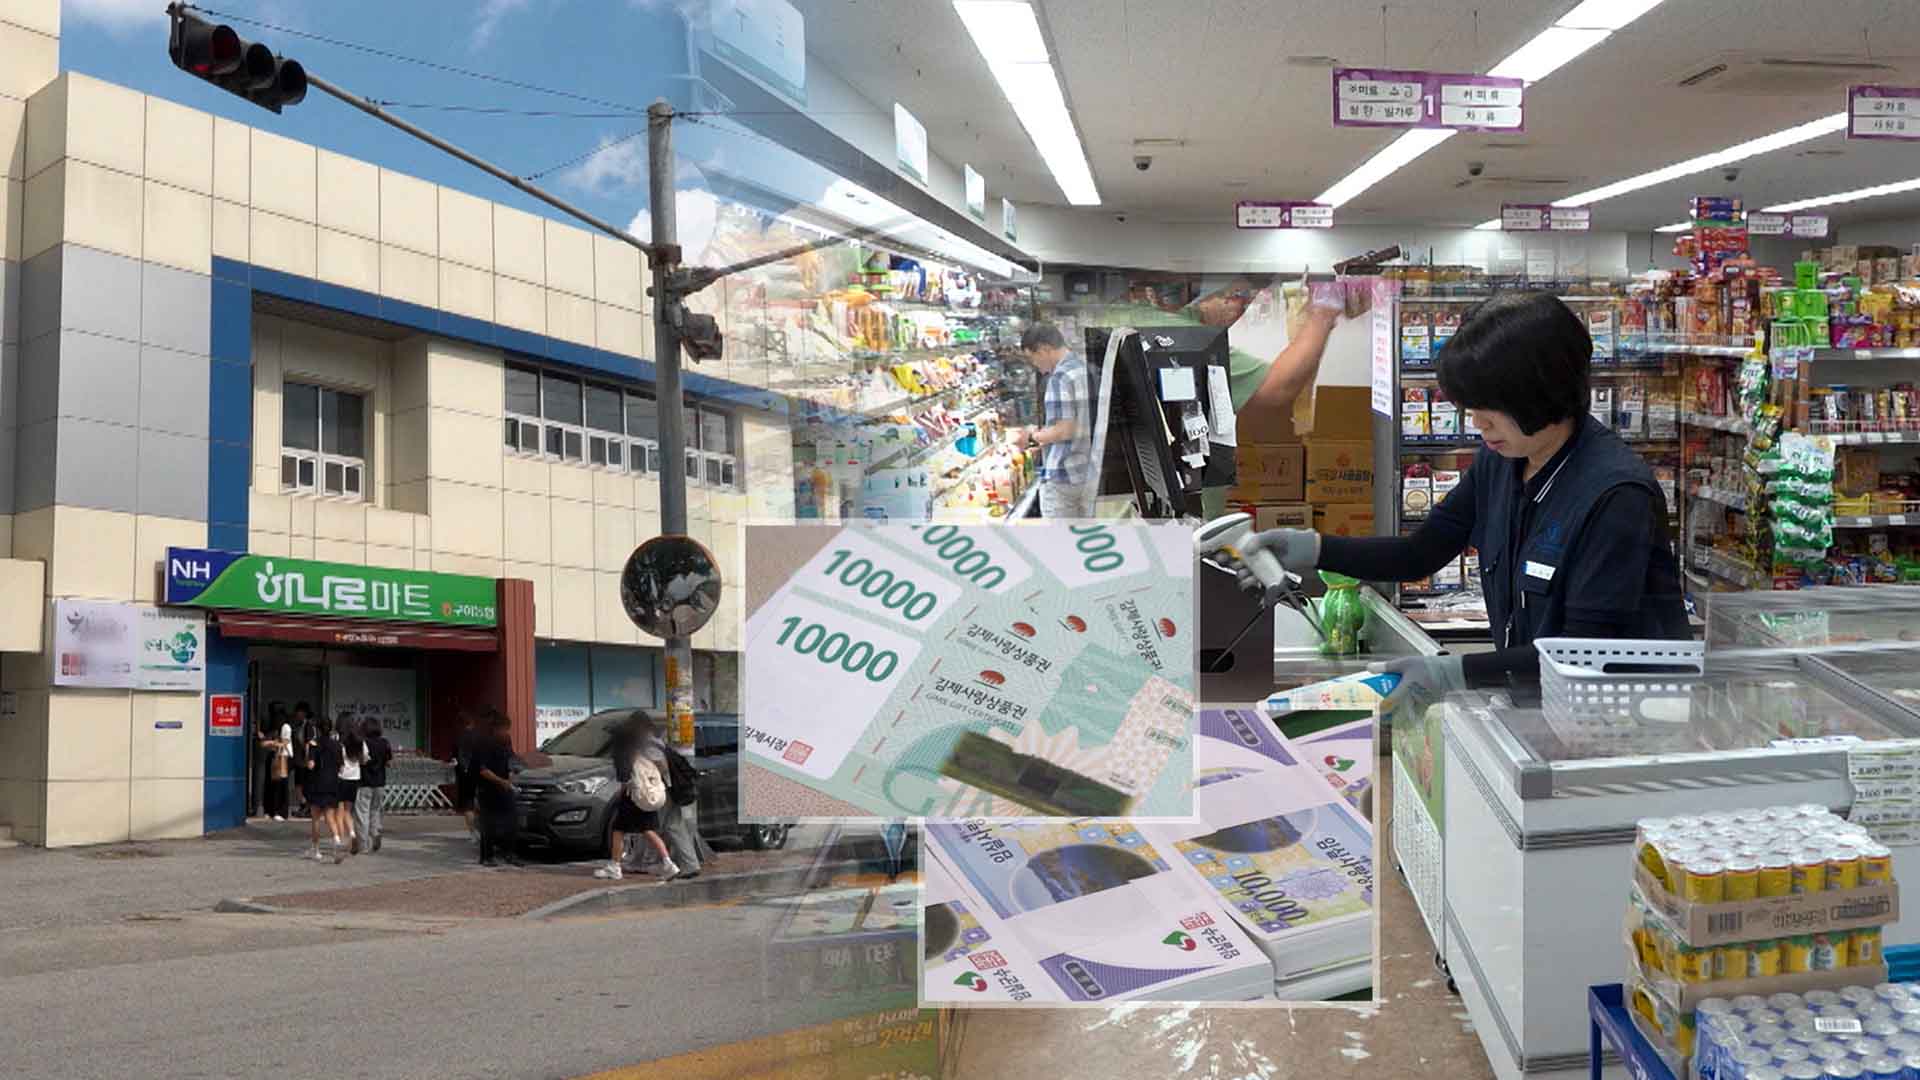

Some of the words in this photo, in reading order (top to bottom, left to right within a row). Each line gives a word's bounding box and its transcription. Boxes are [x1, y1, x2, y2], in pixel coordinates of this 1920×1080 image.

[1424, 95, 1434, 116] 1
[172, 559, 211, 580] NH
[255, 561, 432, 616] 하나로마트
[823, 549, 937, 621] 10000
[776, 615, 899, 682] 10000
[967, 623, 1053, 674] 김제사랑상품권
[935, 677, 1028, 721] 김제사랑상품권
[1232, 870, 1309, 921] 10,000
